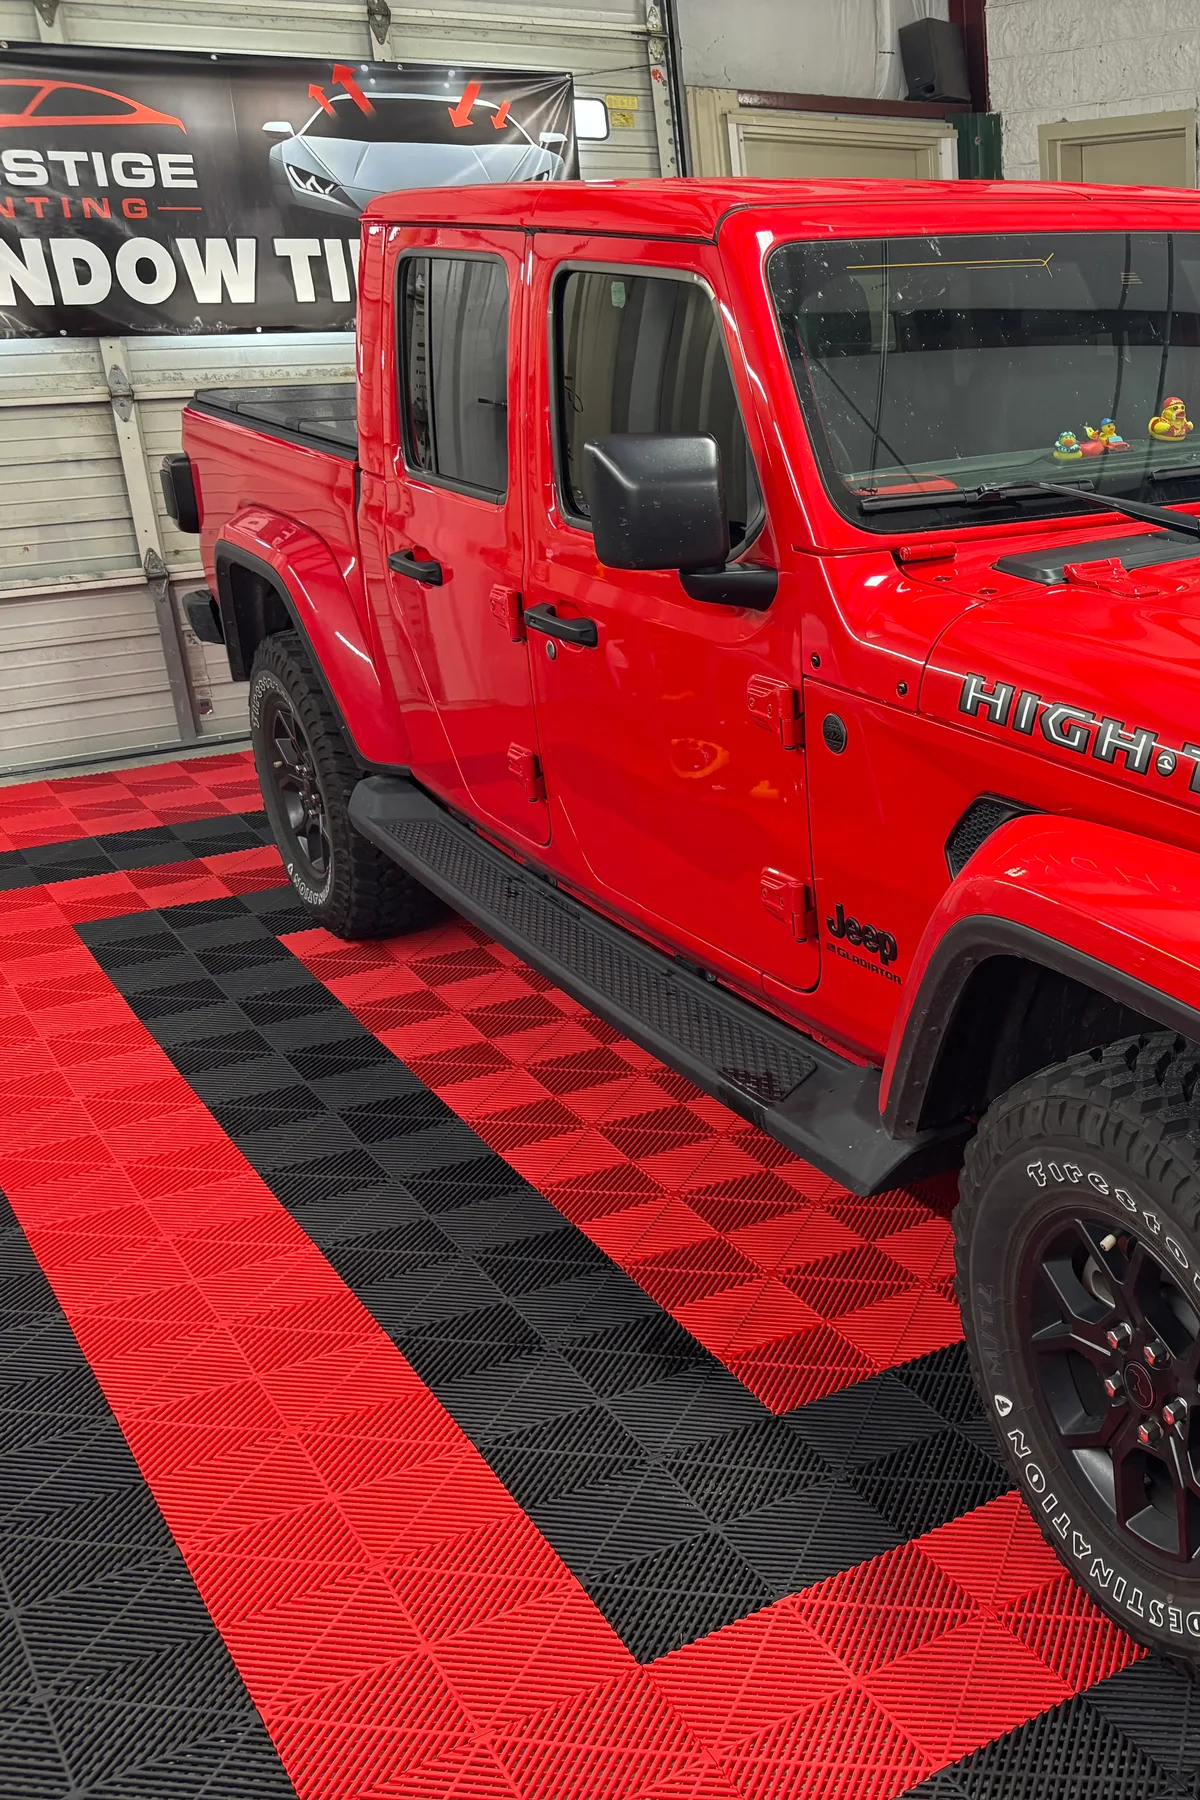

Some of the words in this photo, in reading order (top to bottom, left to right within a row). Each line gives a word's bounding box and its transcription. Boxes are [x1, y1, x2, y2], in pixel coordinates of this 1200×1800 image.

[0, 149, 198, 188] STIGE
[273, 238, 361, 302] TI
[958, 672, 1158, 775] HIGH
[825, 902, 898, 966] Jeep
[836, 947, 902, 986] GLADIATOR
